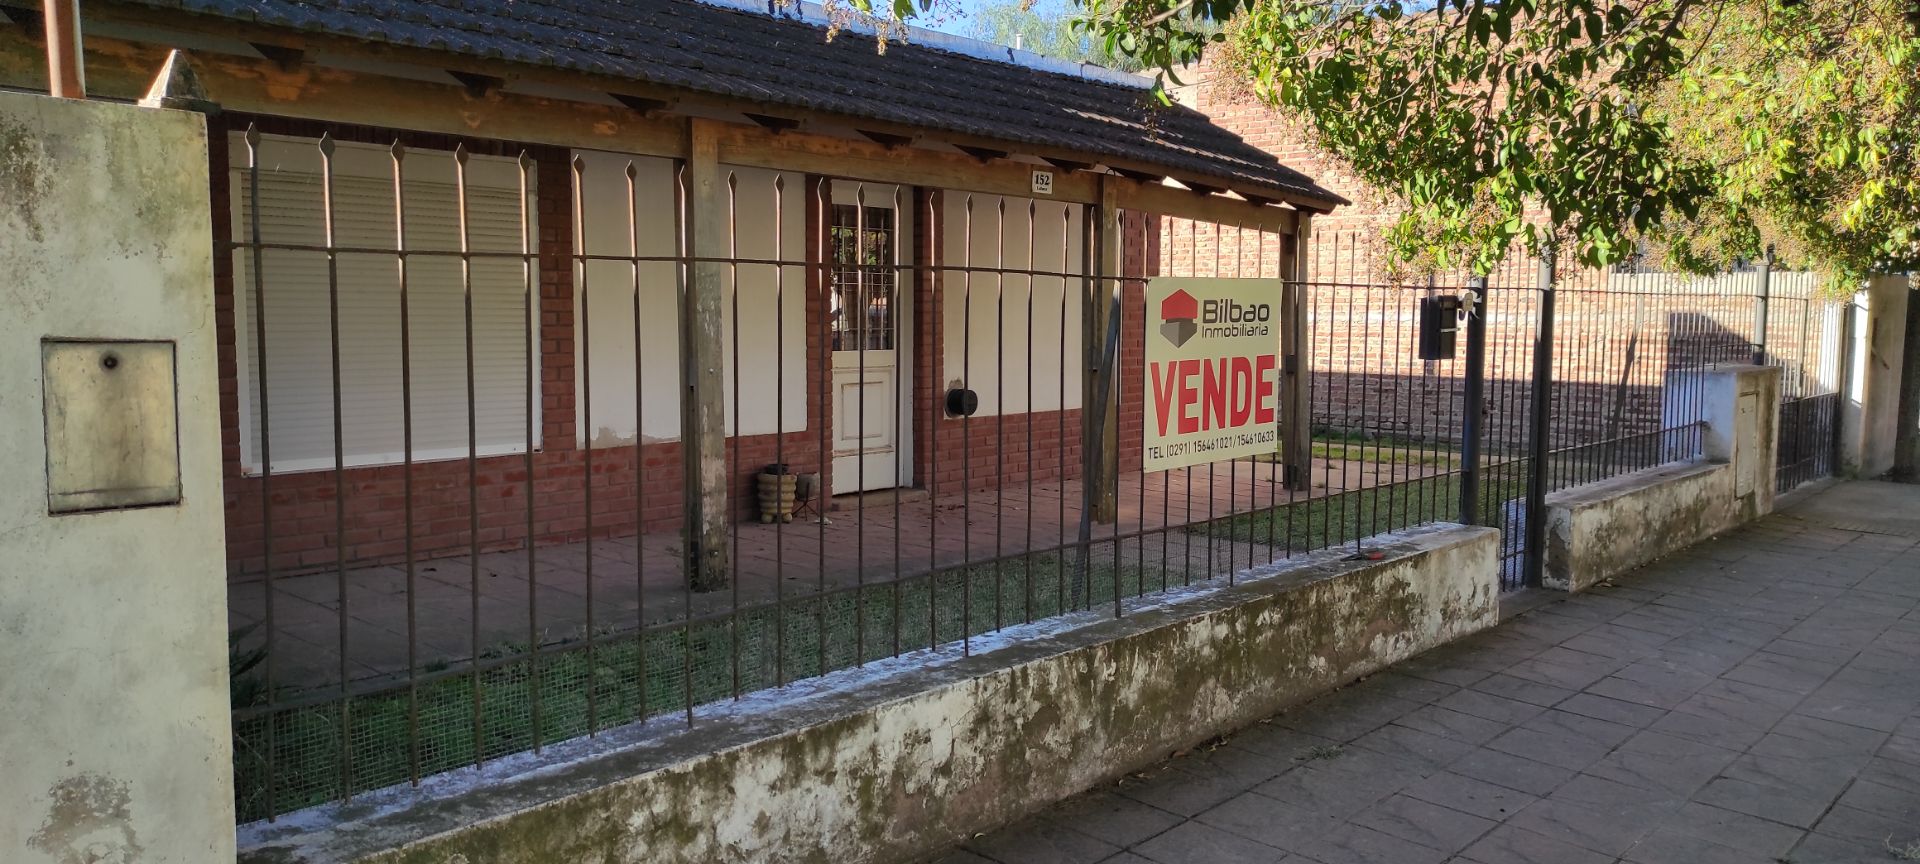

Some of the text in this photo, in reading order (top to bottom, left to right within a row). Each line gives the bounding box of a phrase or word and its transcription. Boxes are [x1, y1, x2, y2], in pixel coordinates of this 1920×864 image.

[1035, 174, 1050, 185] 152
[1202, 298, 1270, 323] Bilbao
[1202, 323, 1269, 339] Inmobiliaria
[1150, 354, 1275, 438] VENDE
[1148, 446, 1164, 459] TEL
[1166, 441, 1191, 458] (0291)
